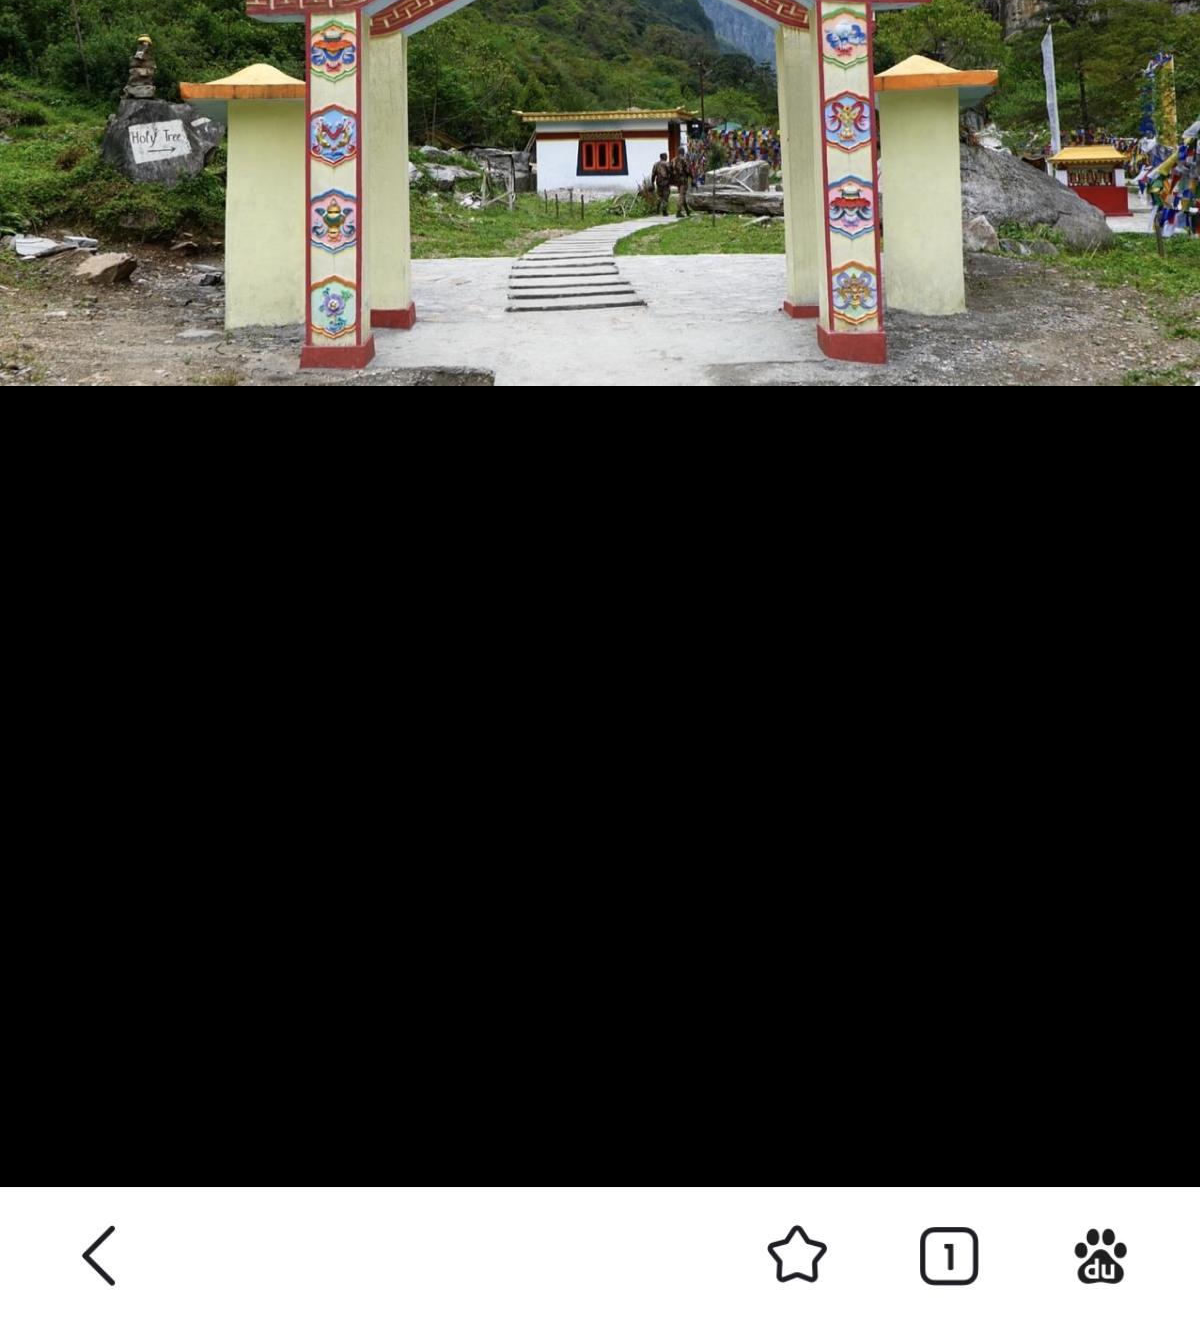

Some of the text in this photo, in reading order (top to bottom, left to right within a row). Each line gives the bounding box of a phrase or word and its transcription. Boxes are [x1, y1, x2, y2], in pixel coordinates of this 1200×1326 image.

[131, 129, 181, 148] Holy Tree
[943, 1243, 955, 1271] 1
[1084, 1258, 1115, 1280] du
